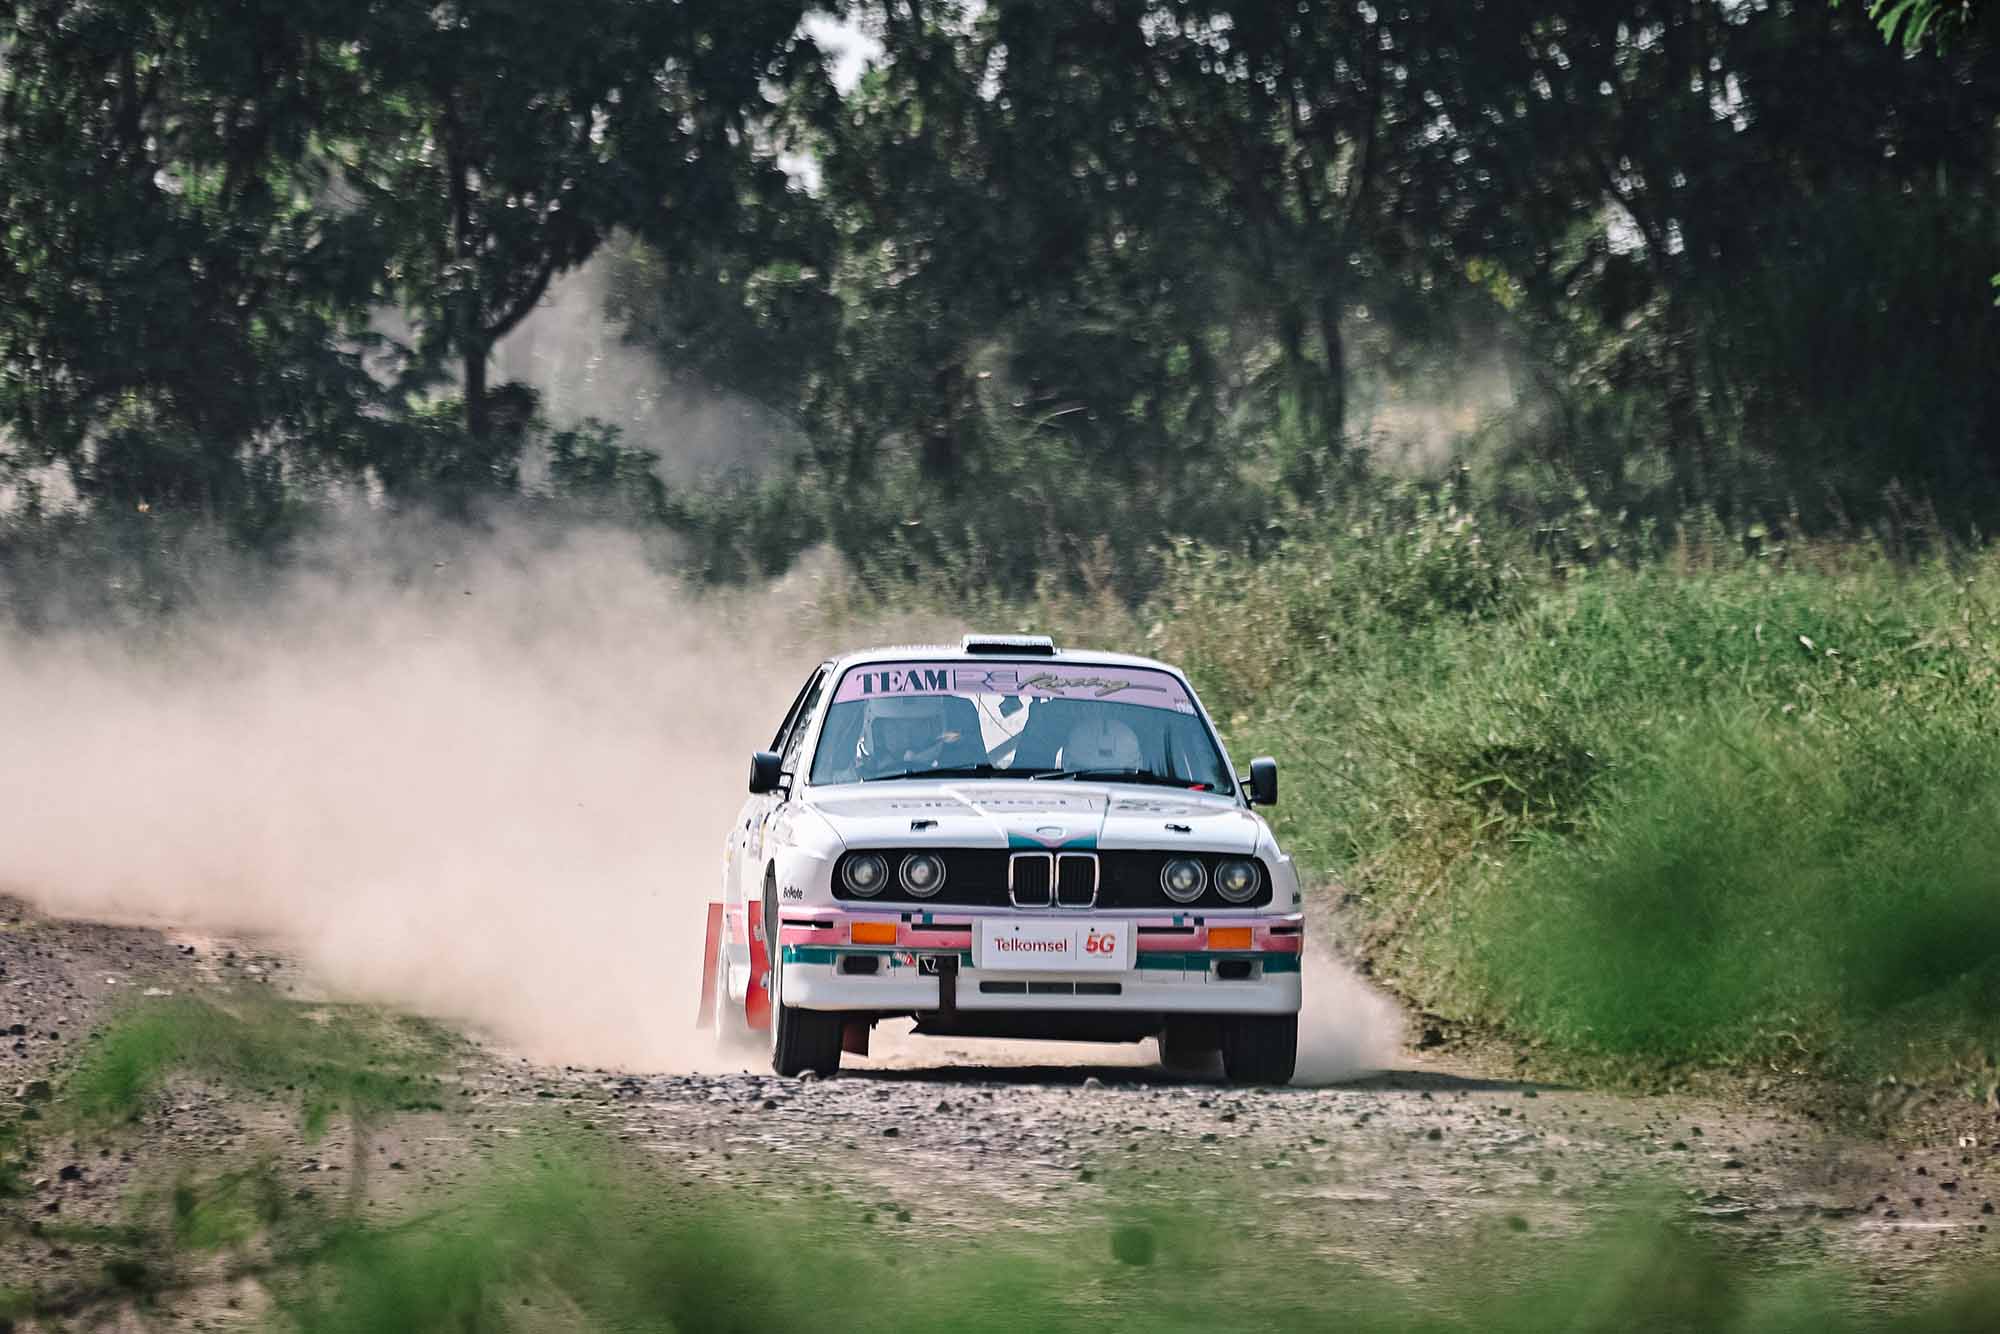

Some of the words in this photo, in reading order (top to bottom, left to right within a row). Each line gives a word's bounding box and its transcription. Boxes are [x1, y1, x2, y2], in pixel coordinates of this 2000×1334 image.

[857, 670, 948, 694] TEAM
[994, 938, 1068, 953] Telkomsel
[1086, 933, 1116, 954] 5G
